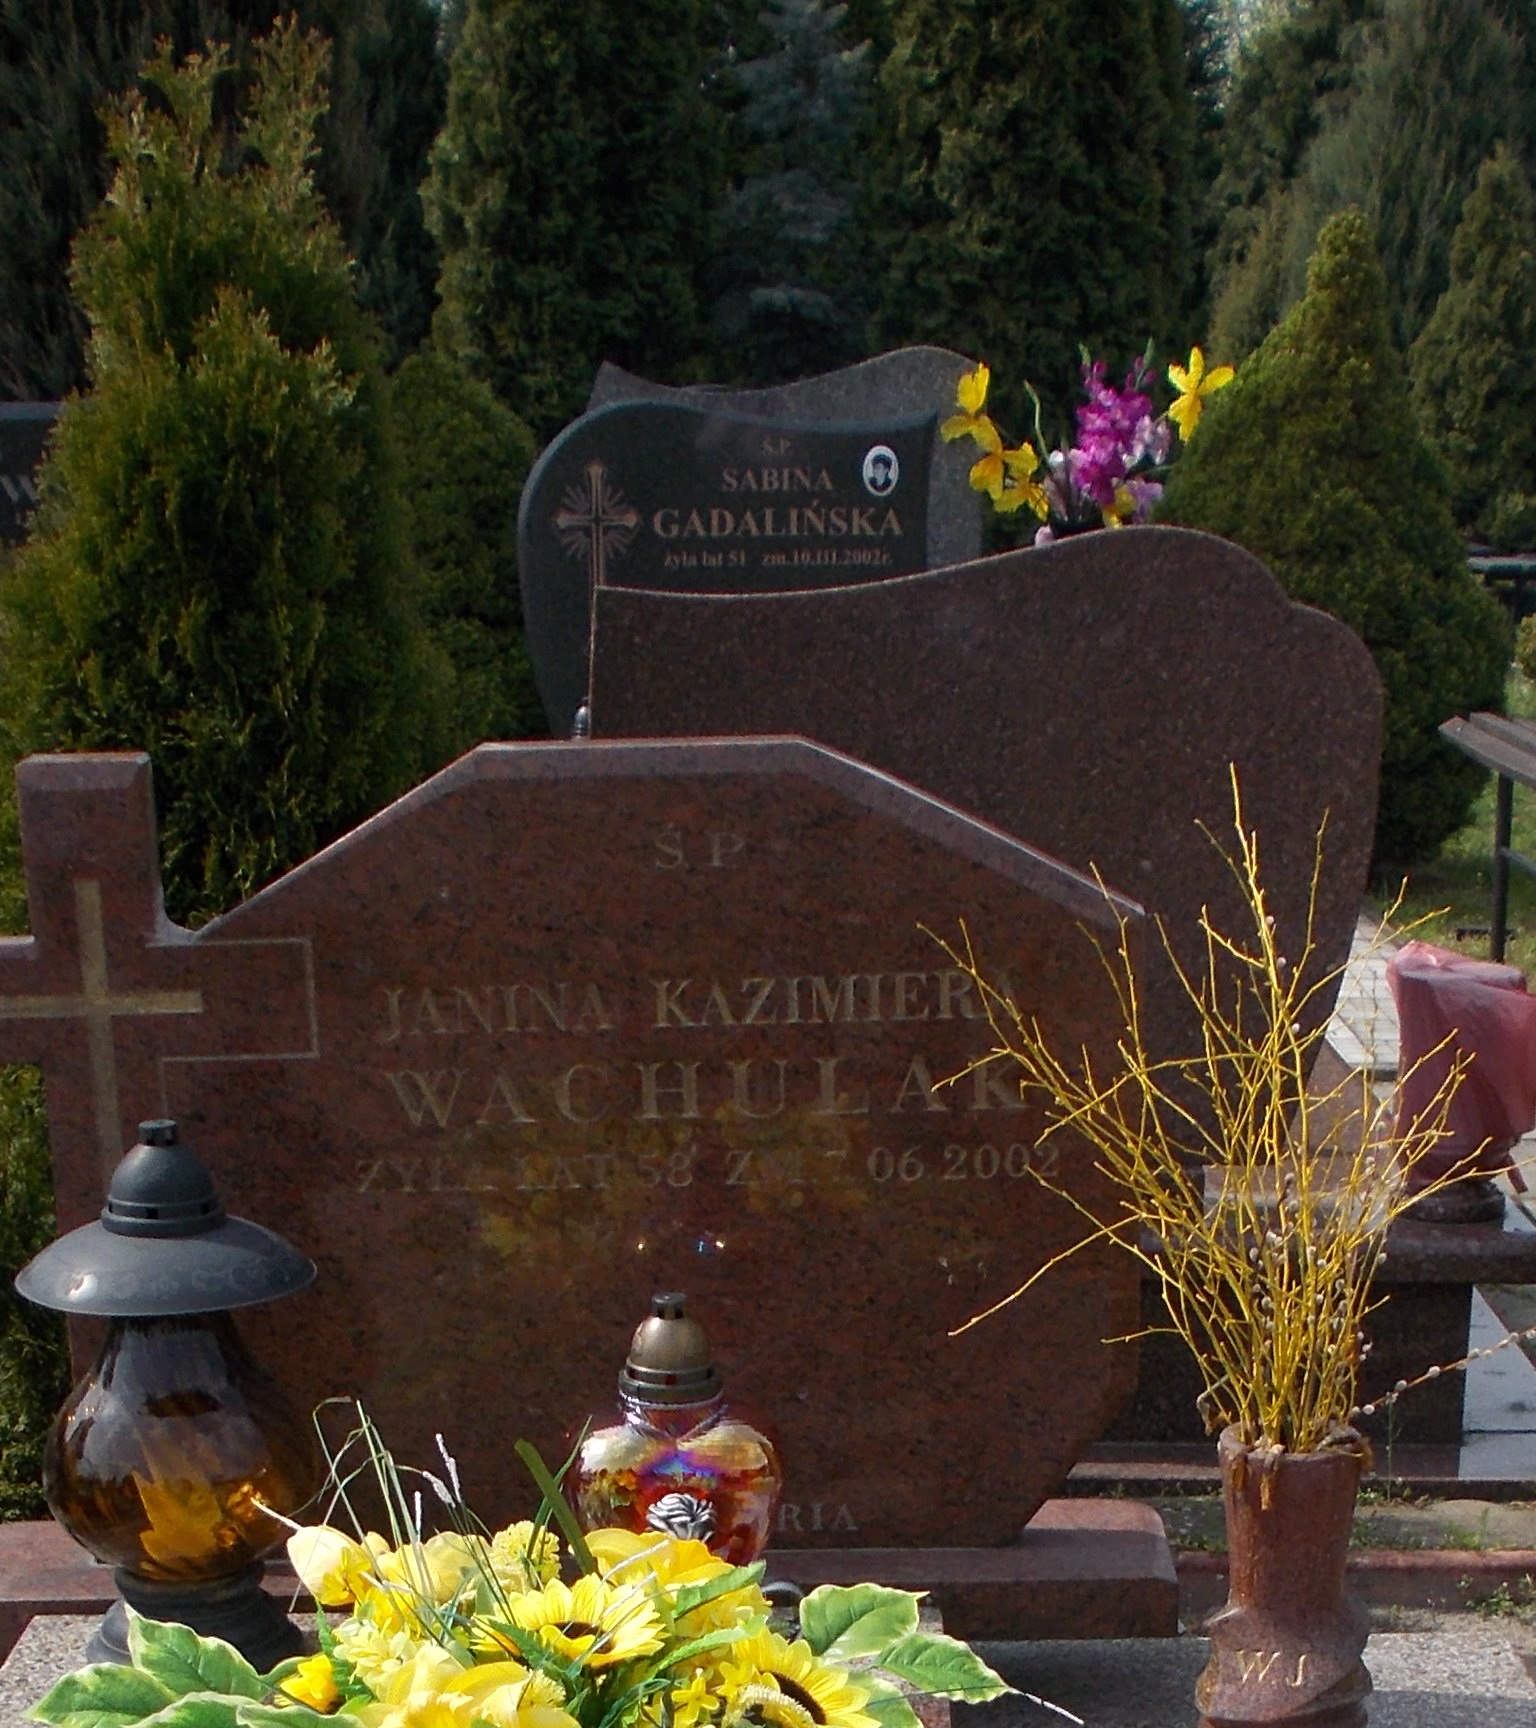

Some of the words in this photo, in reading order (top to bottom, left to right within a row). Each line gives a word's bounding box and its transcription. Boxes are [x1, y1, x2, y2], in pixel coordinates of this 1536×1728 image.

[720, 466, 834, 493] SABINA
[652, 498, 904, 539] GADALIŃSKA
[380, 978, 616, 1042] JANINA
[380, 1052, 1032, 1129] WACHULAK
[776, 1502, 860, 1532] RIA
